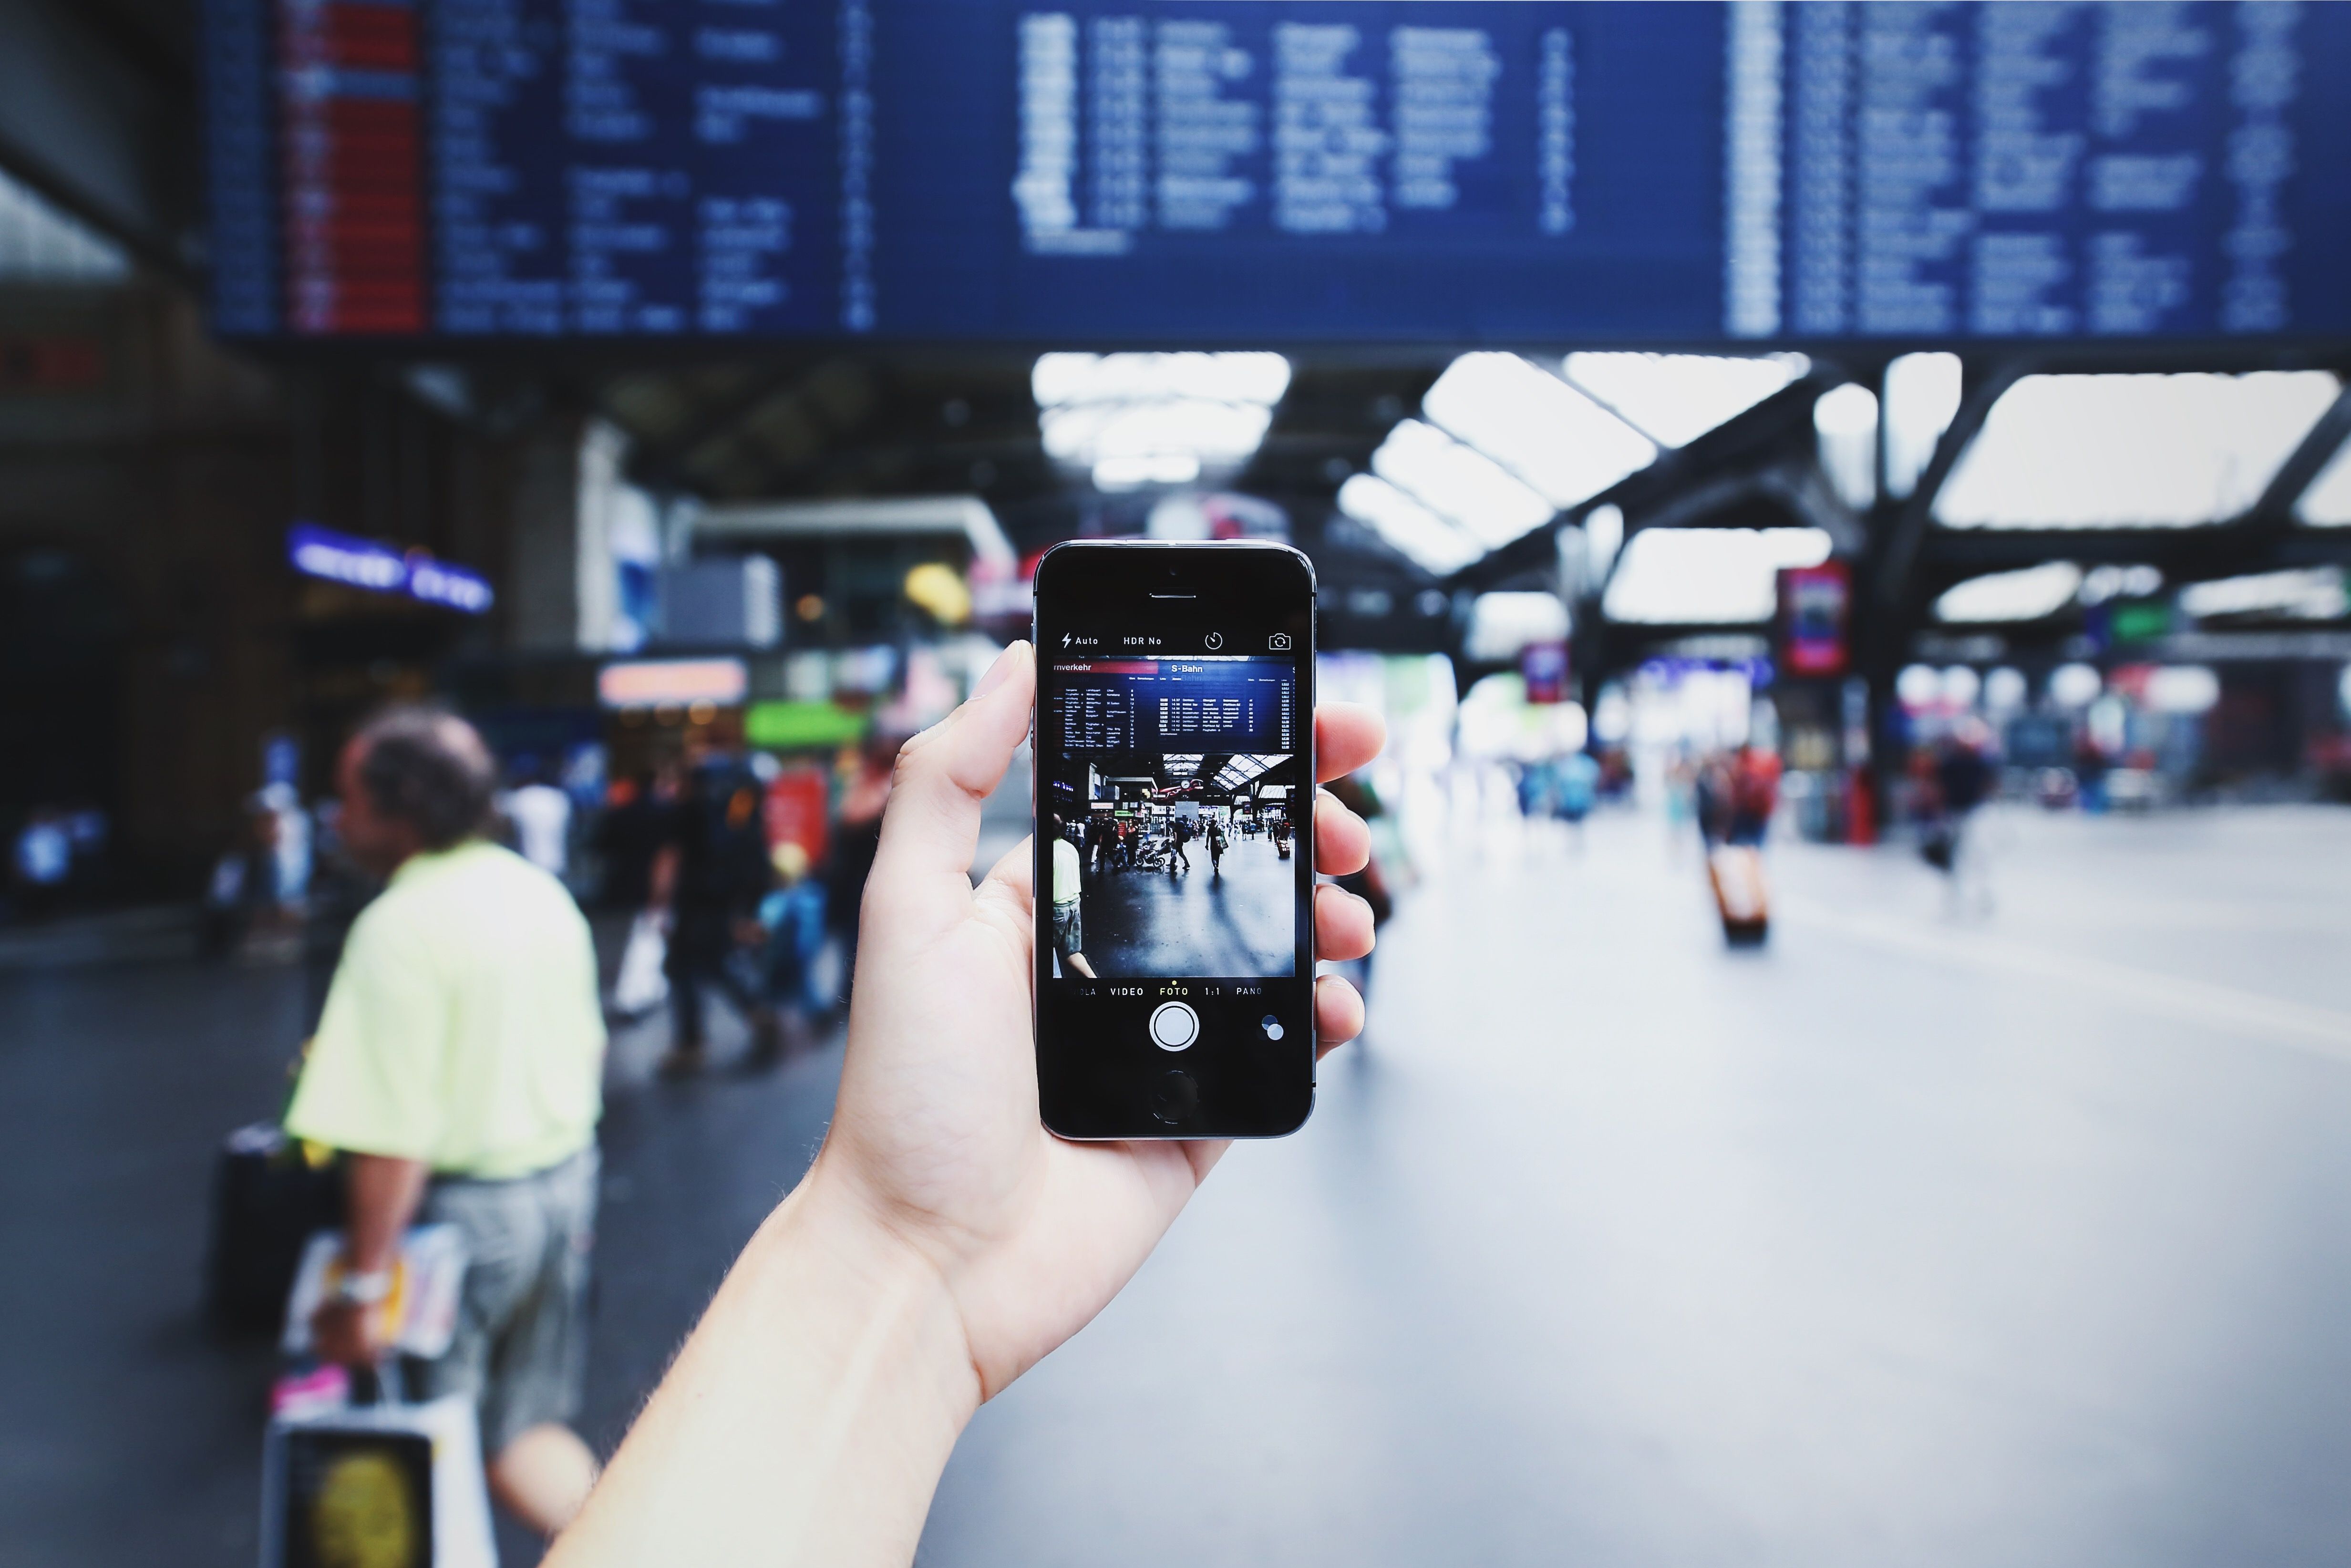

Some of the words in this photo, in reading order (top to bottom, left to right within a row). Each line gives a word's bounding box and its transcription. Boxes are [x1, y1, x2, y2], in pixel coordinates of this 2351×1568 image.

[1075, 637, 1098, 645] Auto
[1124, 637, 1144, 645] HDR
[1148, 637, 1161, 645] No
[1171, 664, 1203, 672] S-Bahn
[1110, 988, 1144, 996] VIDEO
[1205, 987, 1219, 995] 1:1
